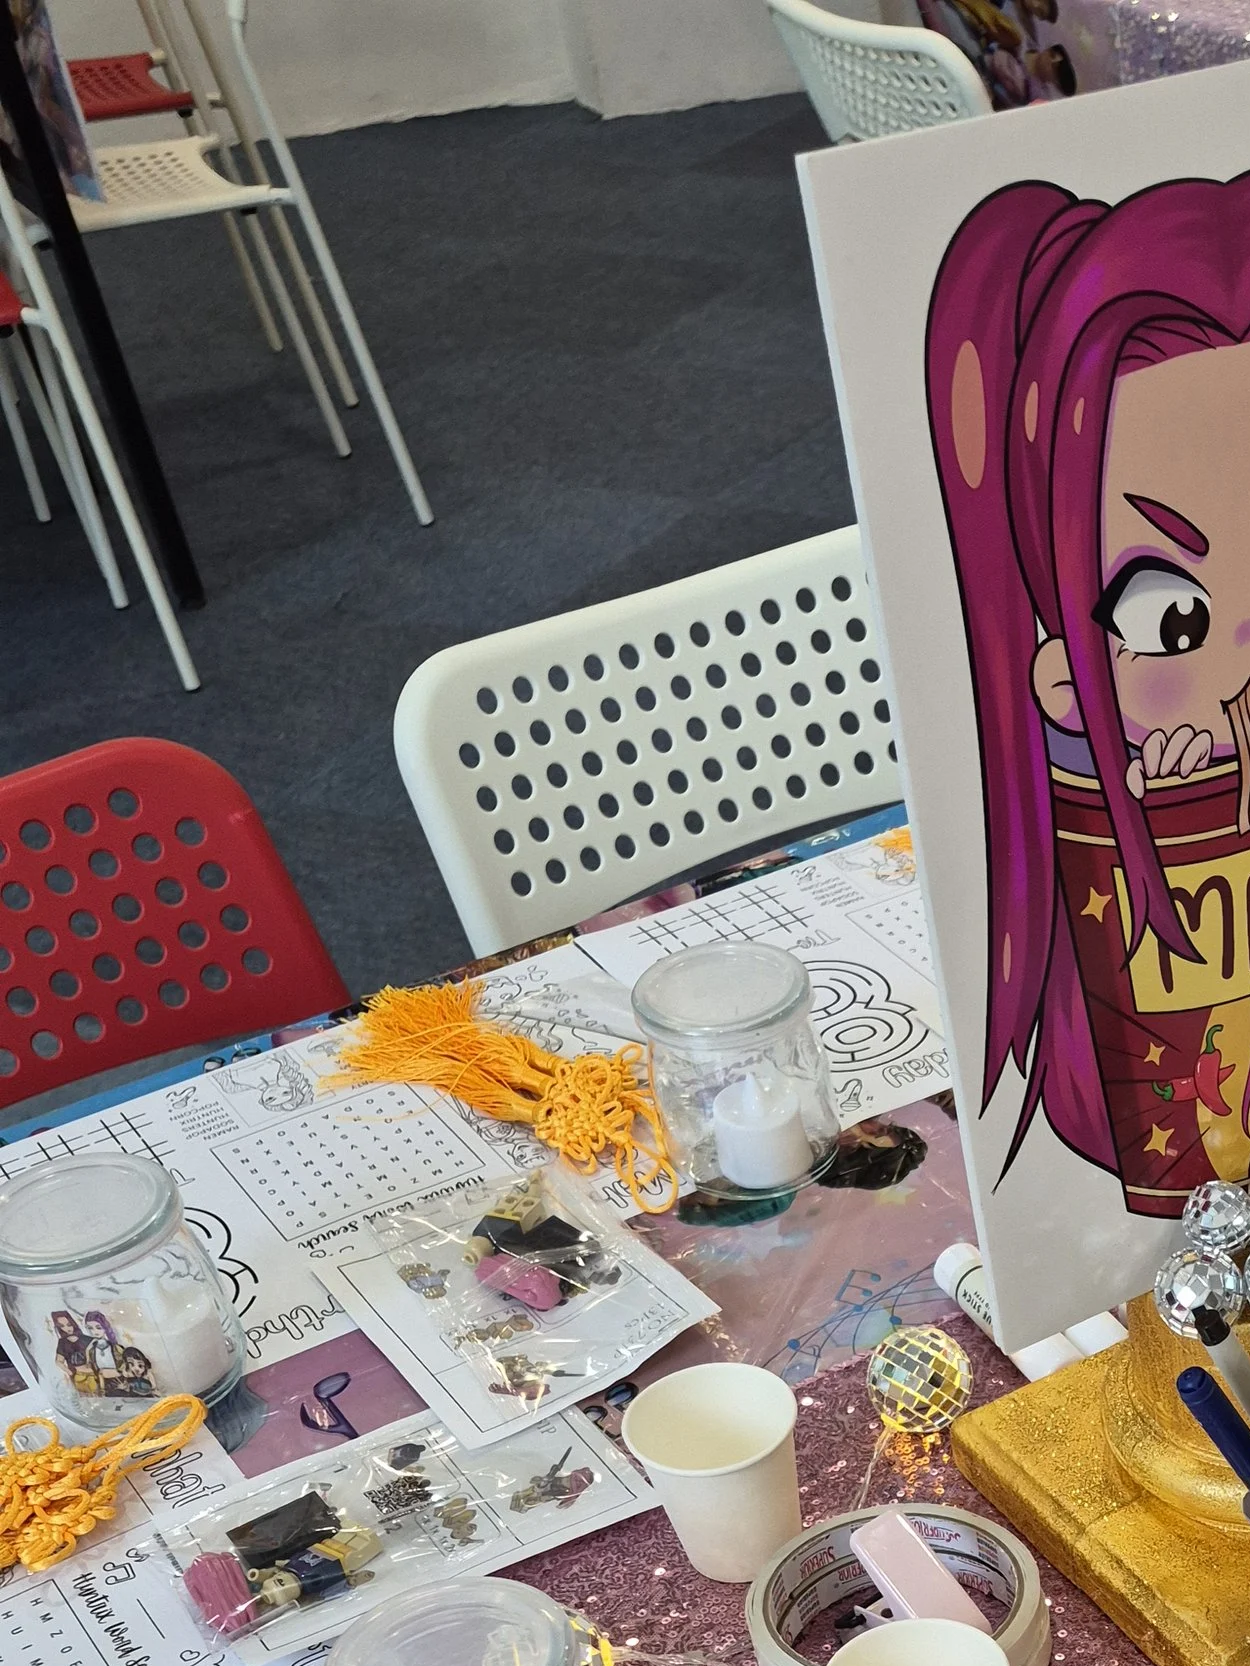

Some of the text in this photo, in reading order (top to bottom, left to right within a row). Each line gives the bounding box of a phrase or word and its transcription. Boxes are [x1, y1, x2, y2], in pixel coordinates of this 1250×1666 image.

[298, 1220, 359, 1250] Search
[72, 1572, 115, 1624] Huntrix
[104, 1621, 143, 1659] Word
